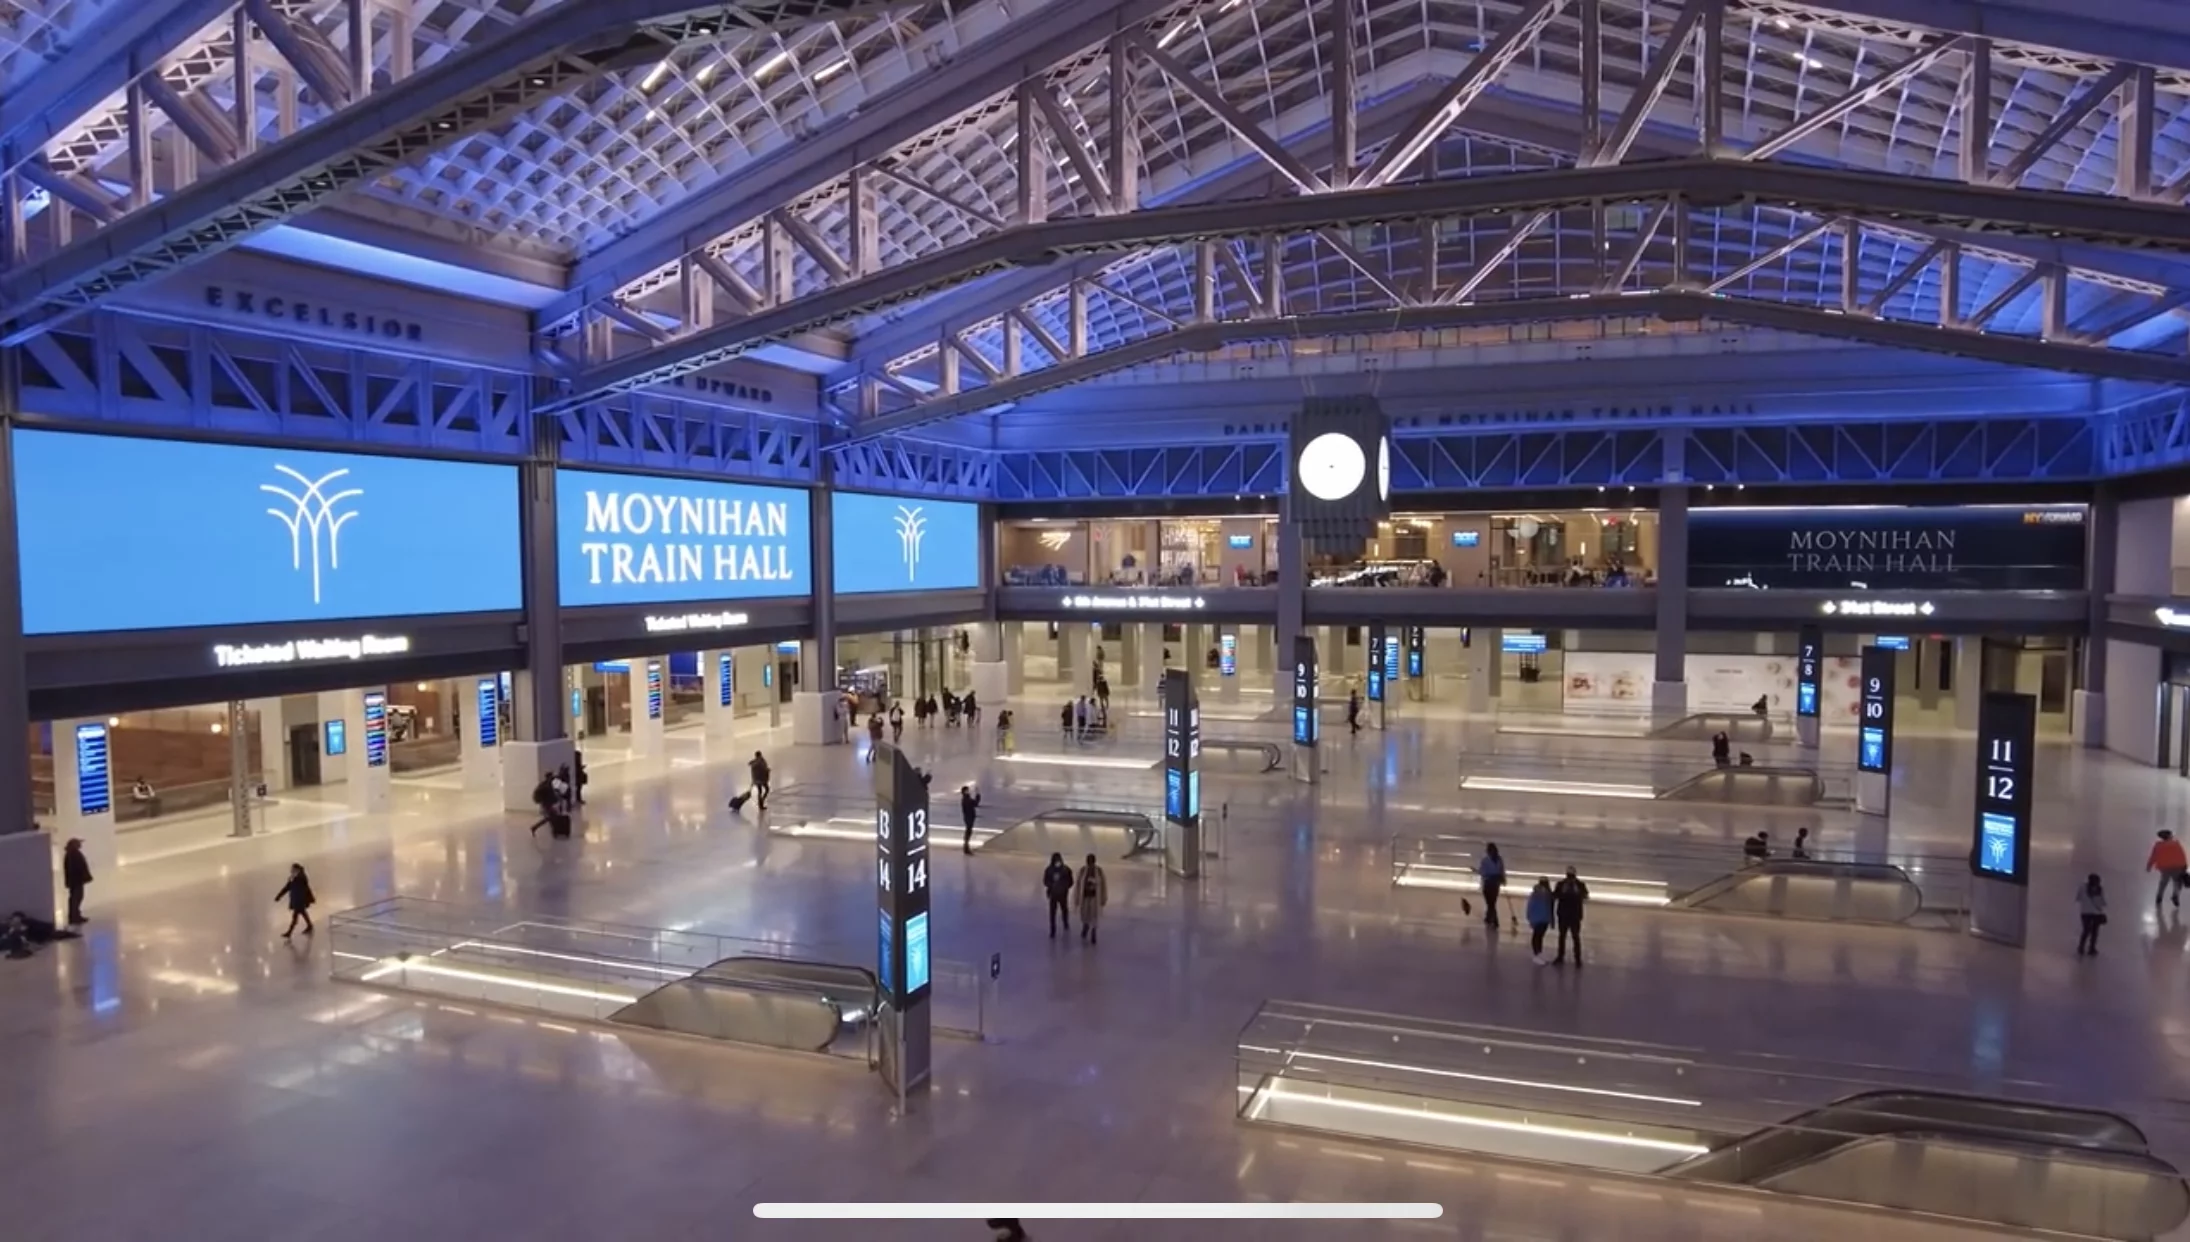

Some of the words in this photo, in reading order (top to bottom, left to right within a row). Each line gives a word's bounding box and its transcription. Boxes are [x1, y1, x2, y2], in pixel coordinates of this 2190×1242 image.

[205, 286, 422, 342] EXCELSIOR
[1591, 405, 1674, 420] TRAIN
[585, 490, 787, 537] MOYNIHAN
[1790, 529, 1957, 550] MOYNIHAN
[582, 542, 702, 584] TRAIN
[714, 544, 793, 581] HALL
[1787, 553, 1876, 573] TRAIN
[1886, 553, 1959, 573] HALL
[1840, 600, 1871, 616] 31st
[1872, 600, 1917, 616] Street
[213, 640, 295, 667] Ticketed
[296, 637, 361, 660] Waiting
[361, 634, 409, 655] Room
[1804, 645, 1813, 657] 7
[1297, 662, 1306, 678] 9
[1804, 664, 1813, 676] 8
[1869, 677, 1881, 693] 9
[1168, 707, 1179, 727] 11
[1866, 702, 1883, 719] 10
[1167, 737, 1180, 758] 12
[1991, 738, 2013, 763] 11
[1987, 775, 2014, 800] 12
[879, 808, 890, 840] 13
[906, 808, 927, 842] 13
[879, 857, 891, 892] 14
[906, 858, 928, 894] 14
